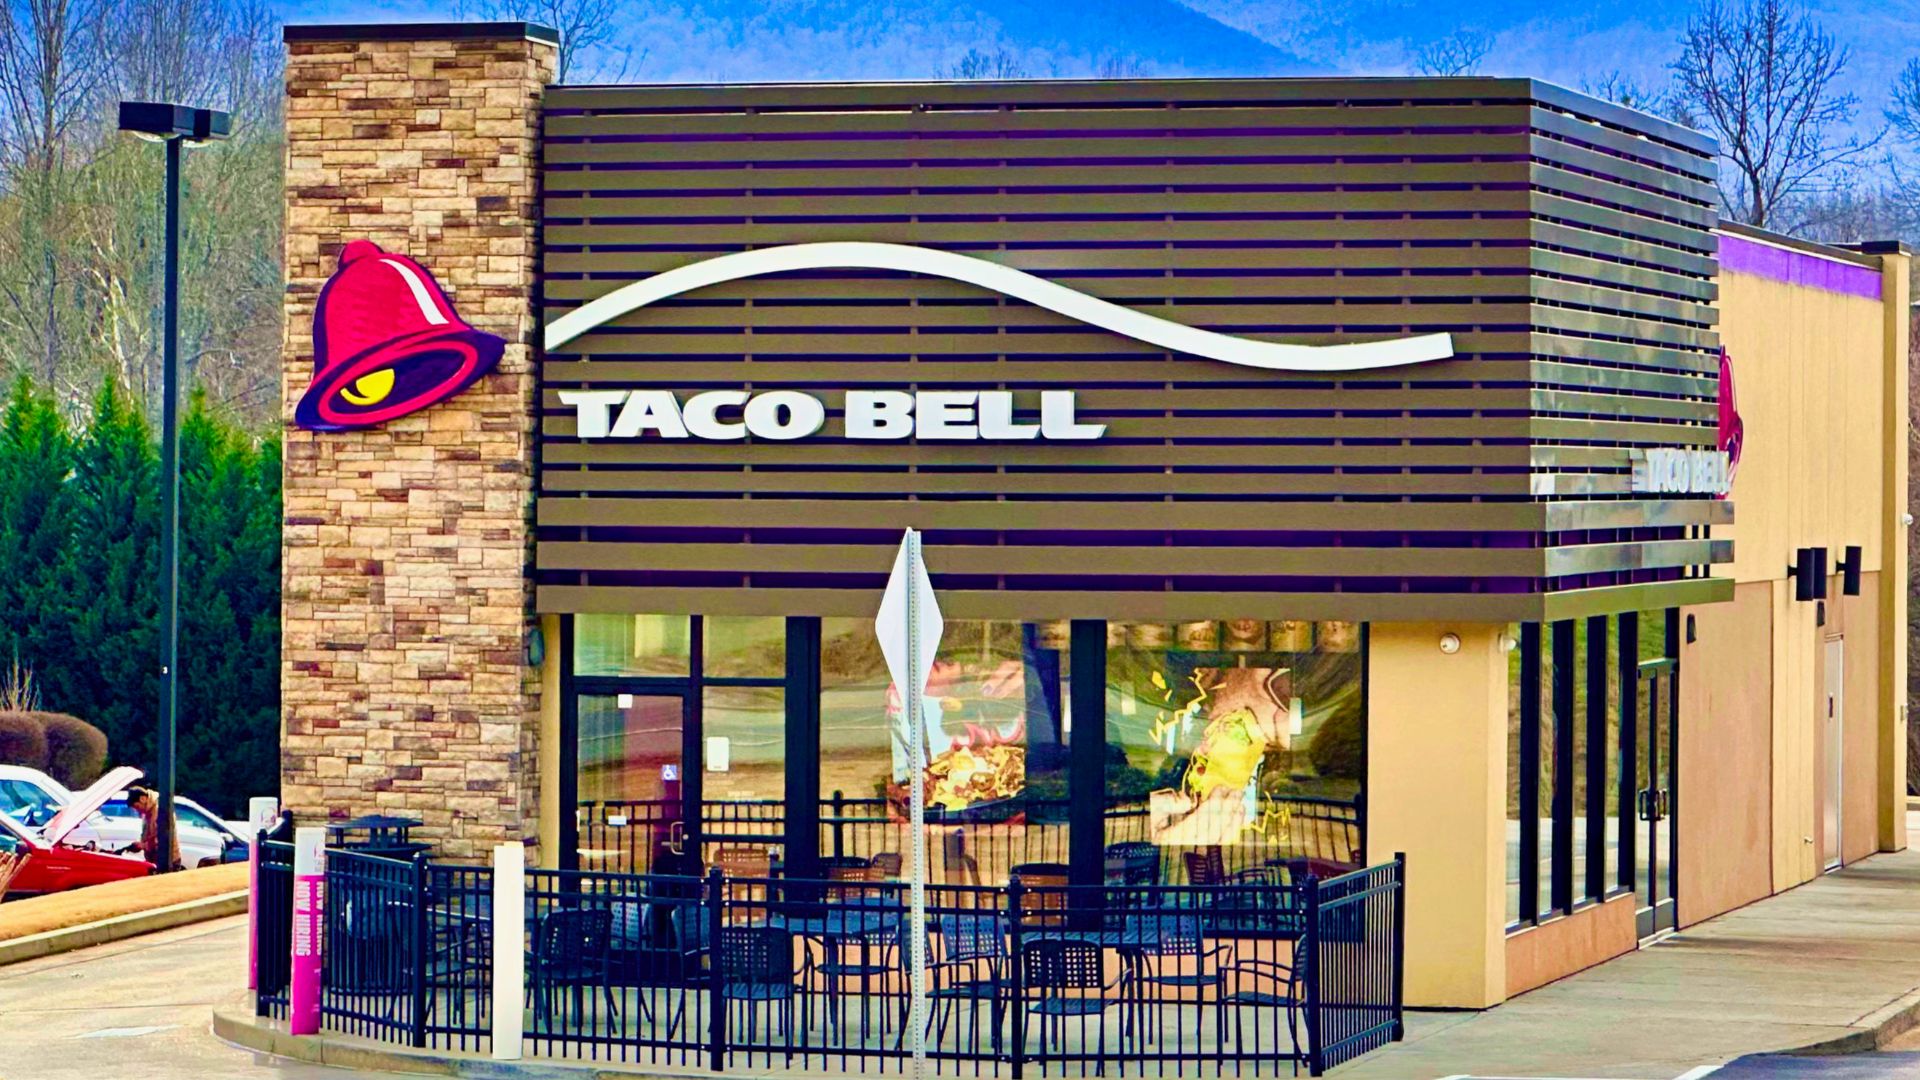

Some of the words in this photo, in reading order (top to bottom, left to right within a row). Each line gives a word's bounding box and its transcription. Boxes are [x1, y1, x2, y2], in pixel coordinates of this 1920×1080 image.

[558, 390, 825, 440] TACO
[844, 390, 1107, 440] BELL
[1646, 448, 1690, 493] TACO
[1691, 450, 1730, 494] BELL
[295, 881, 311, 912] NOW
[295, 914, 311, 956] HIRING
